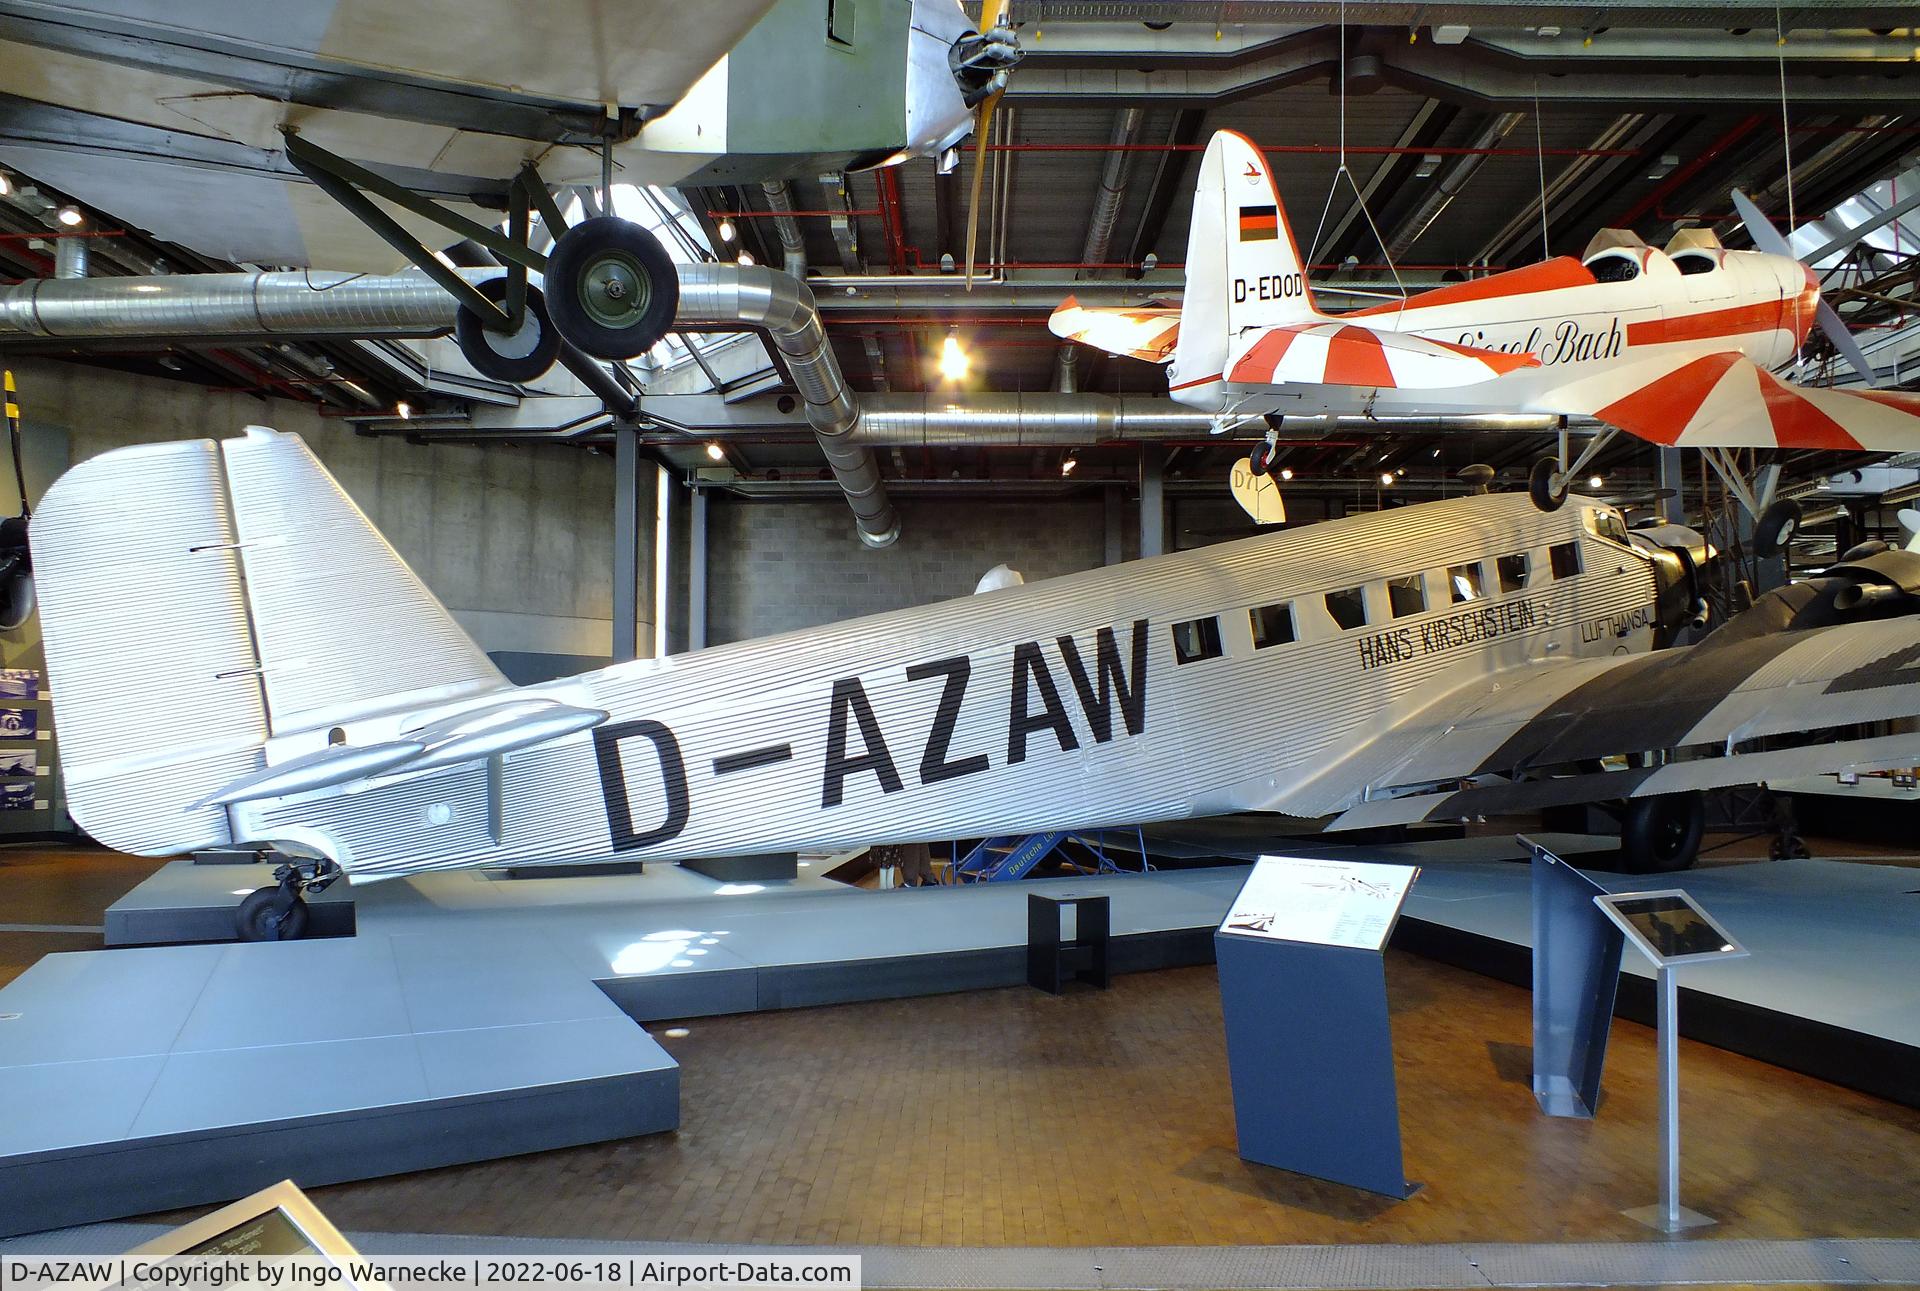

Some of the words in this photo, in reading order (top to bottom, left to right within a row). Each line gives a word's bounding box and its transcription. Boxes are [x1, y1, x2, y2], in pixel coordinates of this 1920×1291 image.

[1234, 272, 1303, 304] D-EDOD
[1541, 317, 1622, 366] Bach
[1358, 628, 1413, 670] HANS
[1420, 599, 1536, 655] KIRSCHSTEIN
[1580, 608, 1649, 644] LUFTHANSA
[592, 619, 1150, 854] D-AZAW
[1008, 842, 1043, 876] Deutsche
